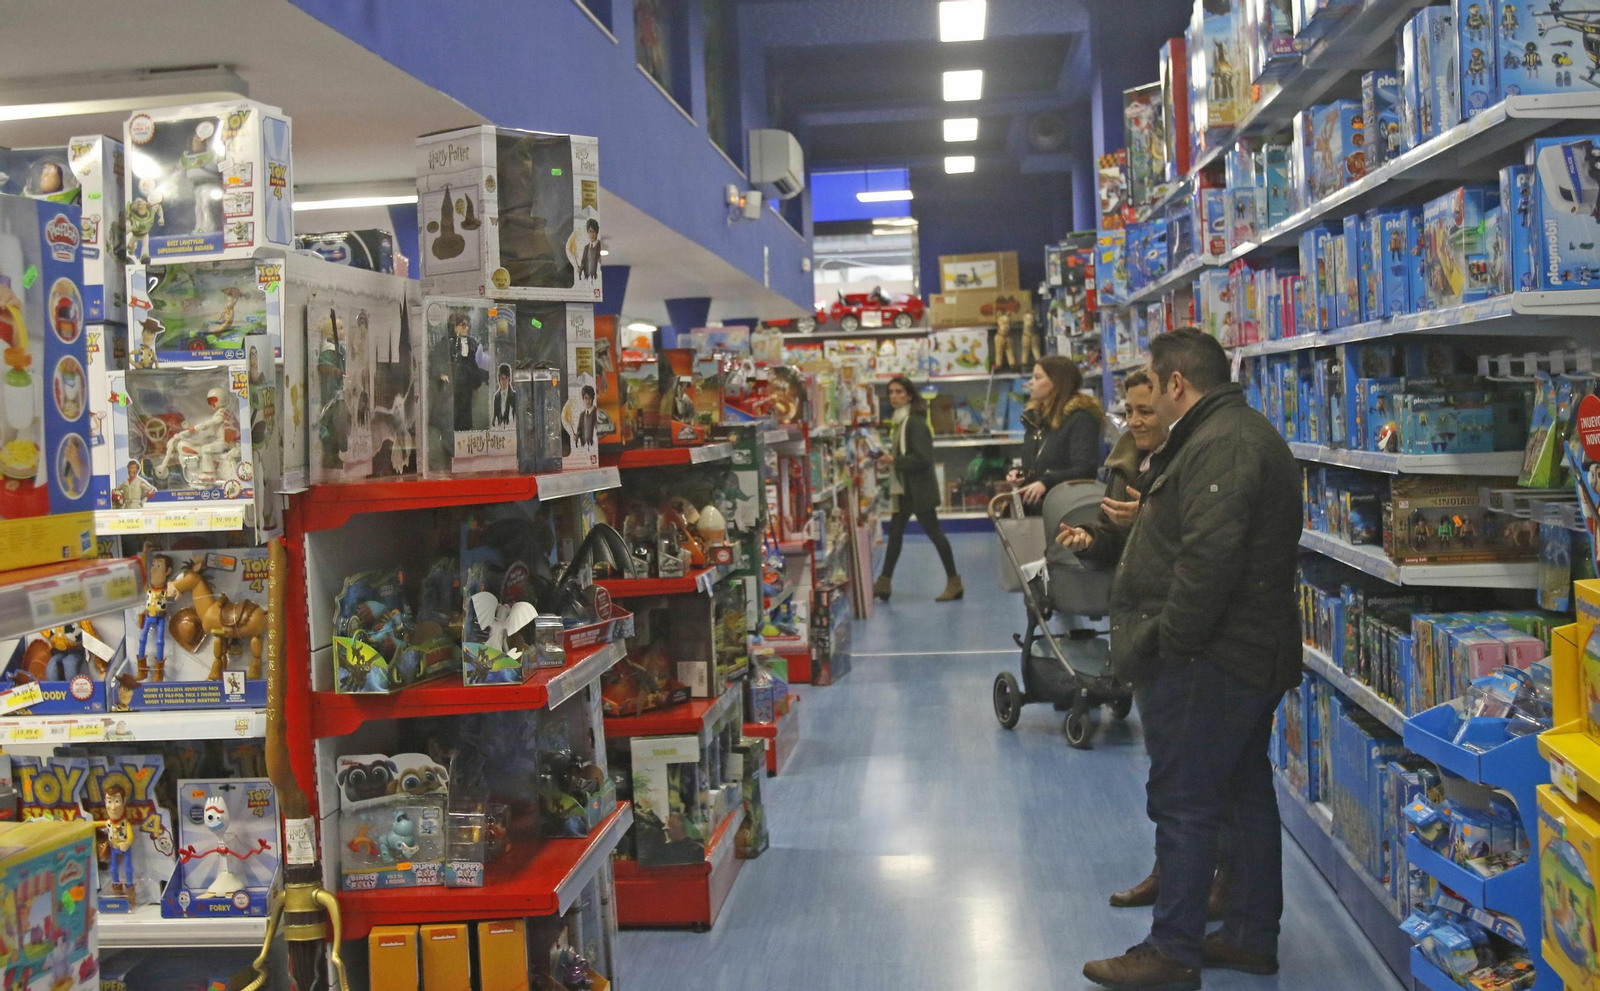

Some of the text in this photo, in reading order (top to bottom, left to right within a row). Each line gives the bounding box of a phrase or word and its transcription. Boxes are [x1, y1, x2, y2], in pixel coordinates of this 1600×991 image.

[428, 144, 470, 169] Harry Potter
[268, 162, 287, 179] TOY
[273, 185, 283, 201] 4
[1544, 218, 1563, 286] playmobil
[258, 264, 282, 276] TOY
[576, 326, 591, 339] Potter
[238, 388, 248, 399] 4
[1413, 396, 1445, 405] playmobil
[466, 431, 506, 454] Harry Potter
[241, 557, 269, 573] TOY
[245, 572, 268, 580] STORY
[249, 580, 264, 593] 4
[1367, 595, 1416, 608] playmobil
[41, 691, 67, 700] OODY
[234, 718, 249, 726] TOY
[12, 765, 85, 806] TOY
[87, 764, 157, 802] TOY
[246, 789, 271, 801] TOY
[90, 805, 150, 821] STRY
[252, 806, 264, 818] 4
[141, 814, 165, 836] 4
[412, 862, 441, 871] PUPPY
[452, 862, 482, 871] PUPPY
[350, 873, 379, 882] BINGO
[208, 904, 232, 912] FORKY
